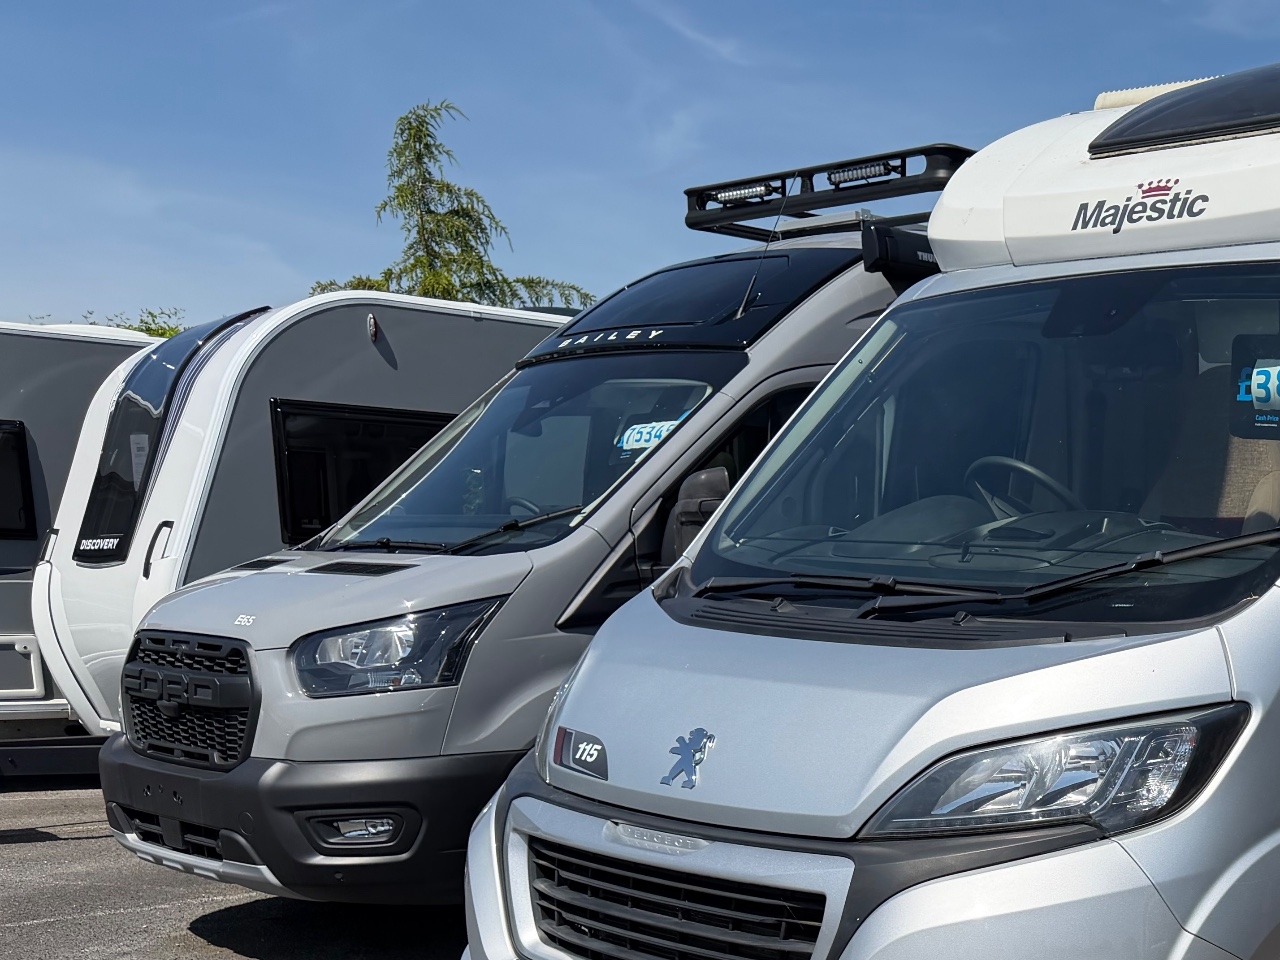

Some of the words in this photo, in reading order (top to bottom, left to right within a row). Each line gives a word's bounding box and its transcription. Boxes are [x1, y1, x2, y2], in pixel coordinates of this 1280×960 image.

[1071, 189, 1210, 234] Majestic
[916, 251, 938, 263] THU
[558, 329, 664, 348] BAILEY
[80, 538, 120, 550] DISCOVERY
[234, 614, 256, 626] E65
[575, 741, 603, 763] 115
